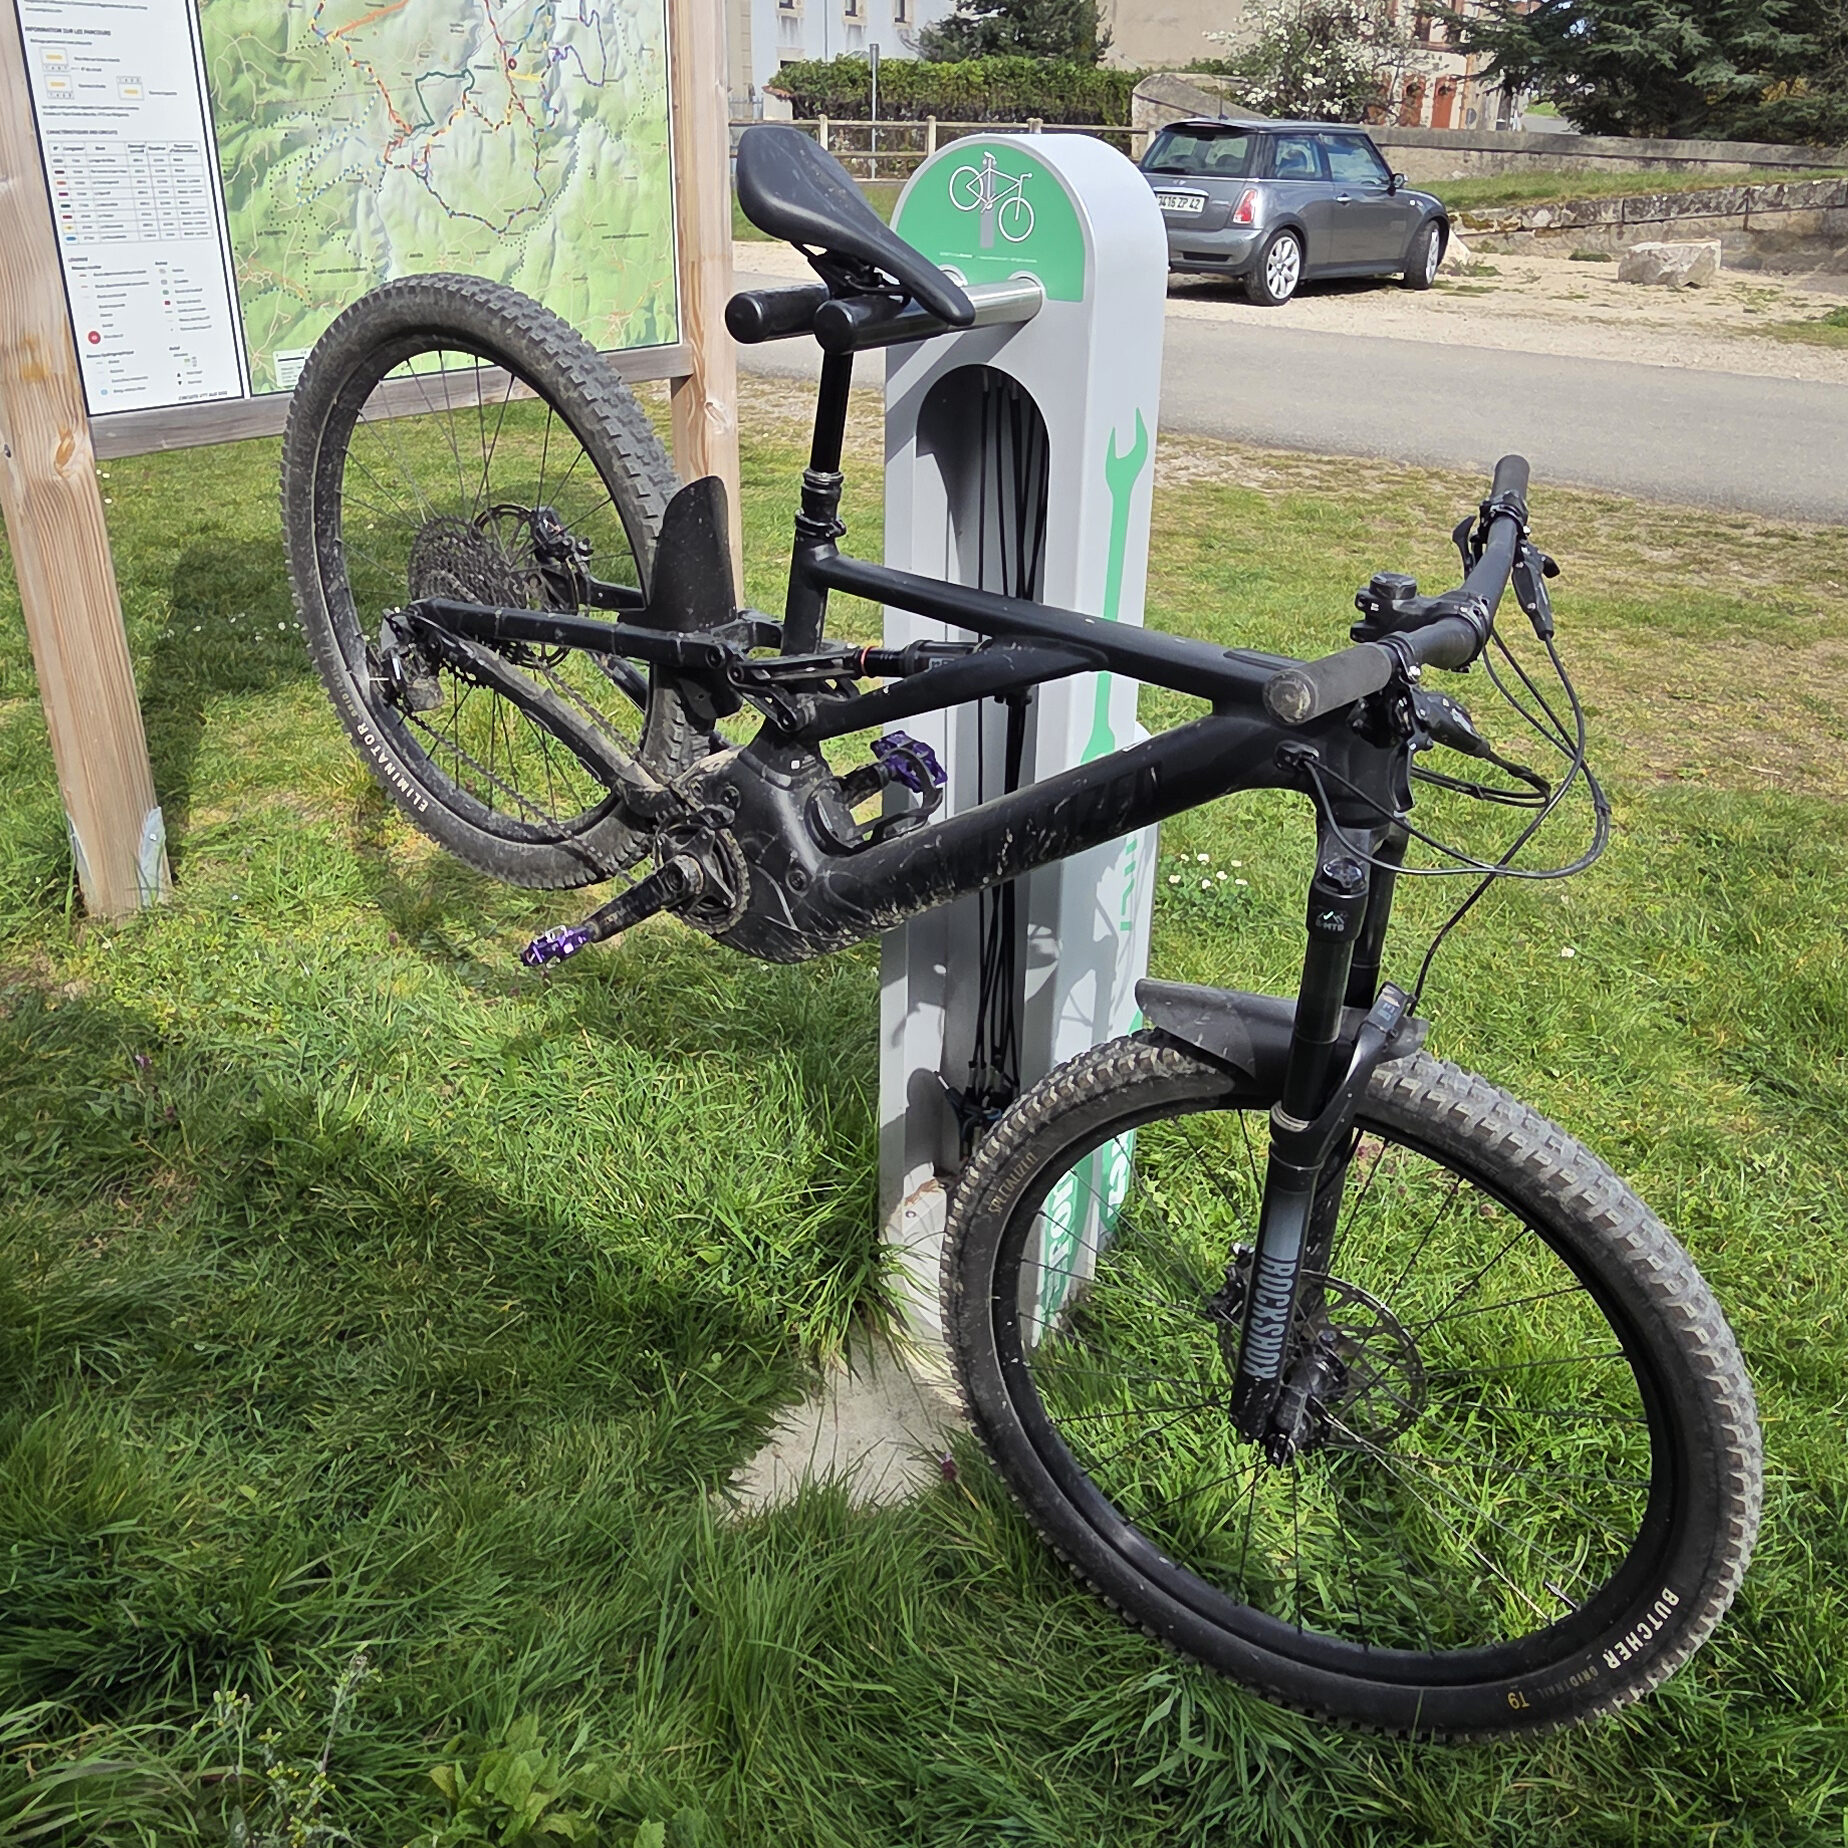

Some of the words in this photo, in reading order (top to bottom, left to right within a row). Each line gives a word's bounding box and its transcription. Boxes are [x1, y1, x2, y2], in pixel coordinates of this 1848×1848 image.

[357, 721, 429, 813] ELIMINATOR
[1242, 1256, 1297, 1379] ROCKSHOX
[1602, 1587, 1680, 1669] BUTCHER
[1507, 1690, 1530, 1710] T9
